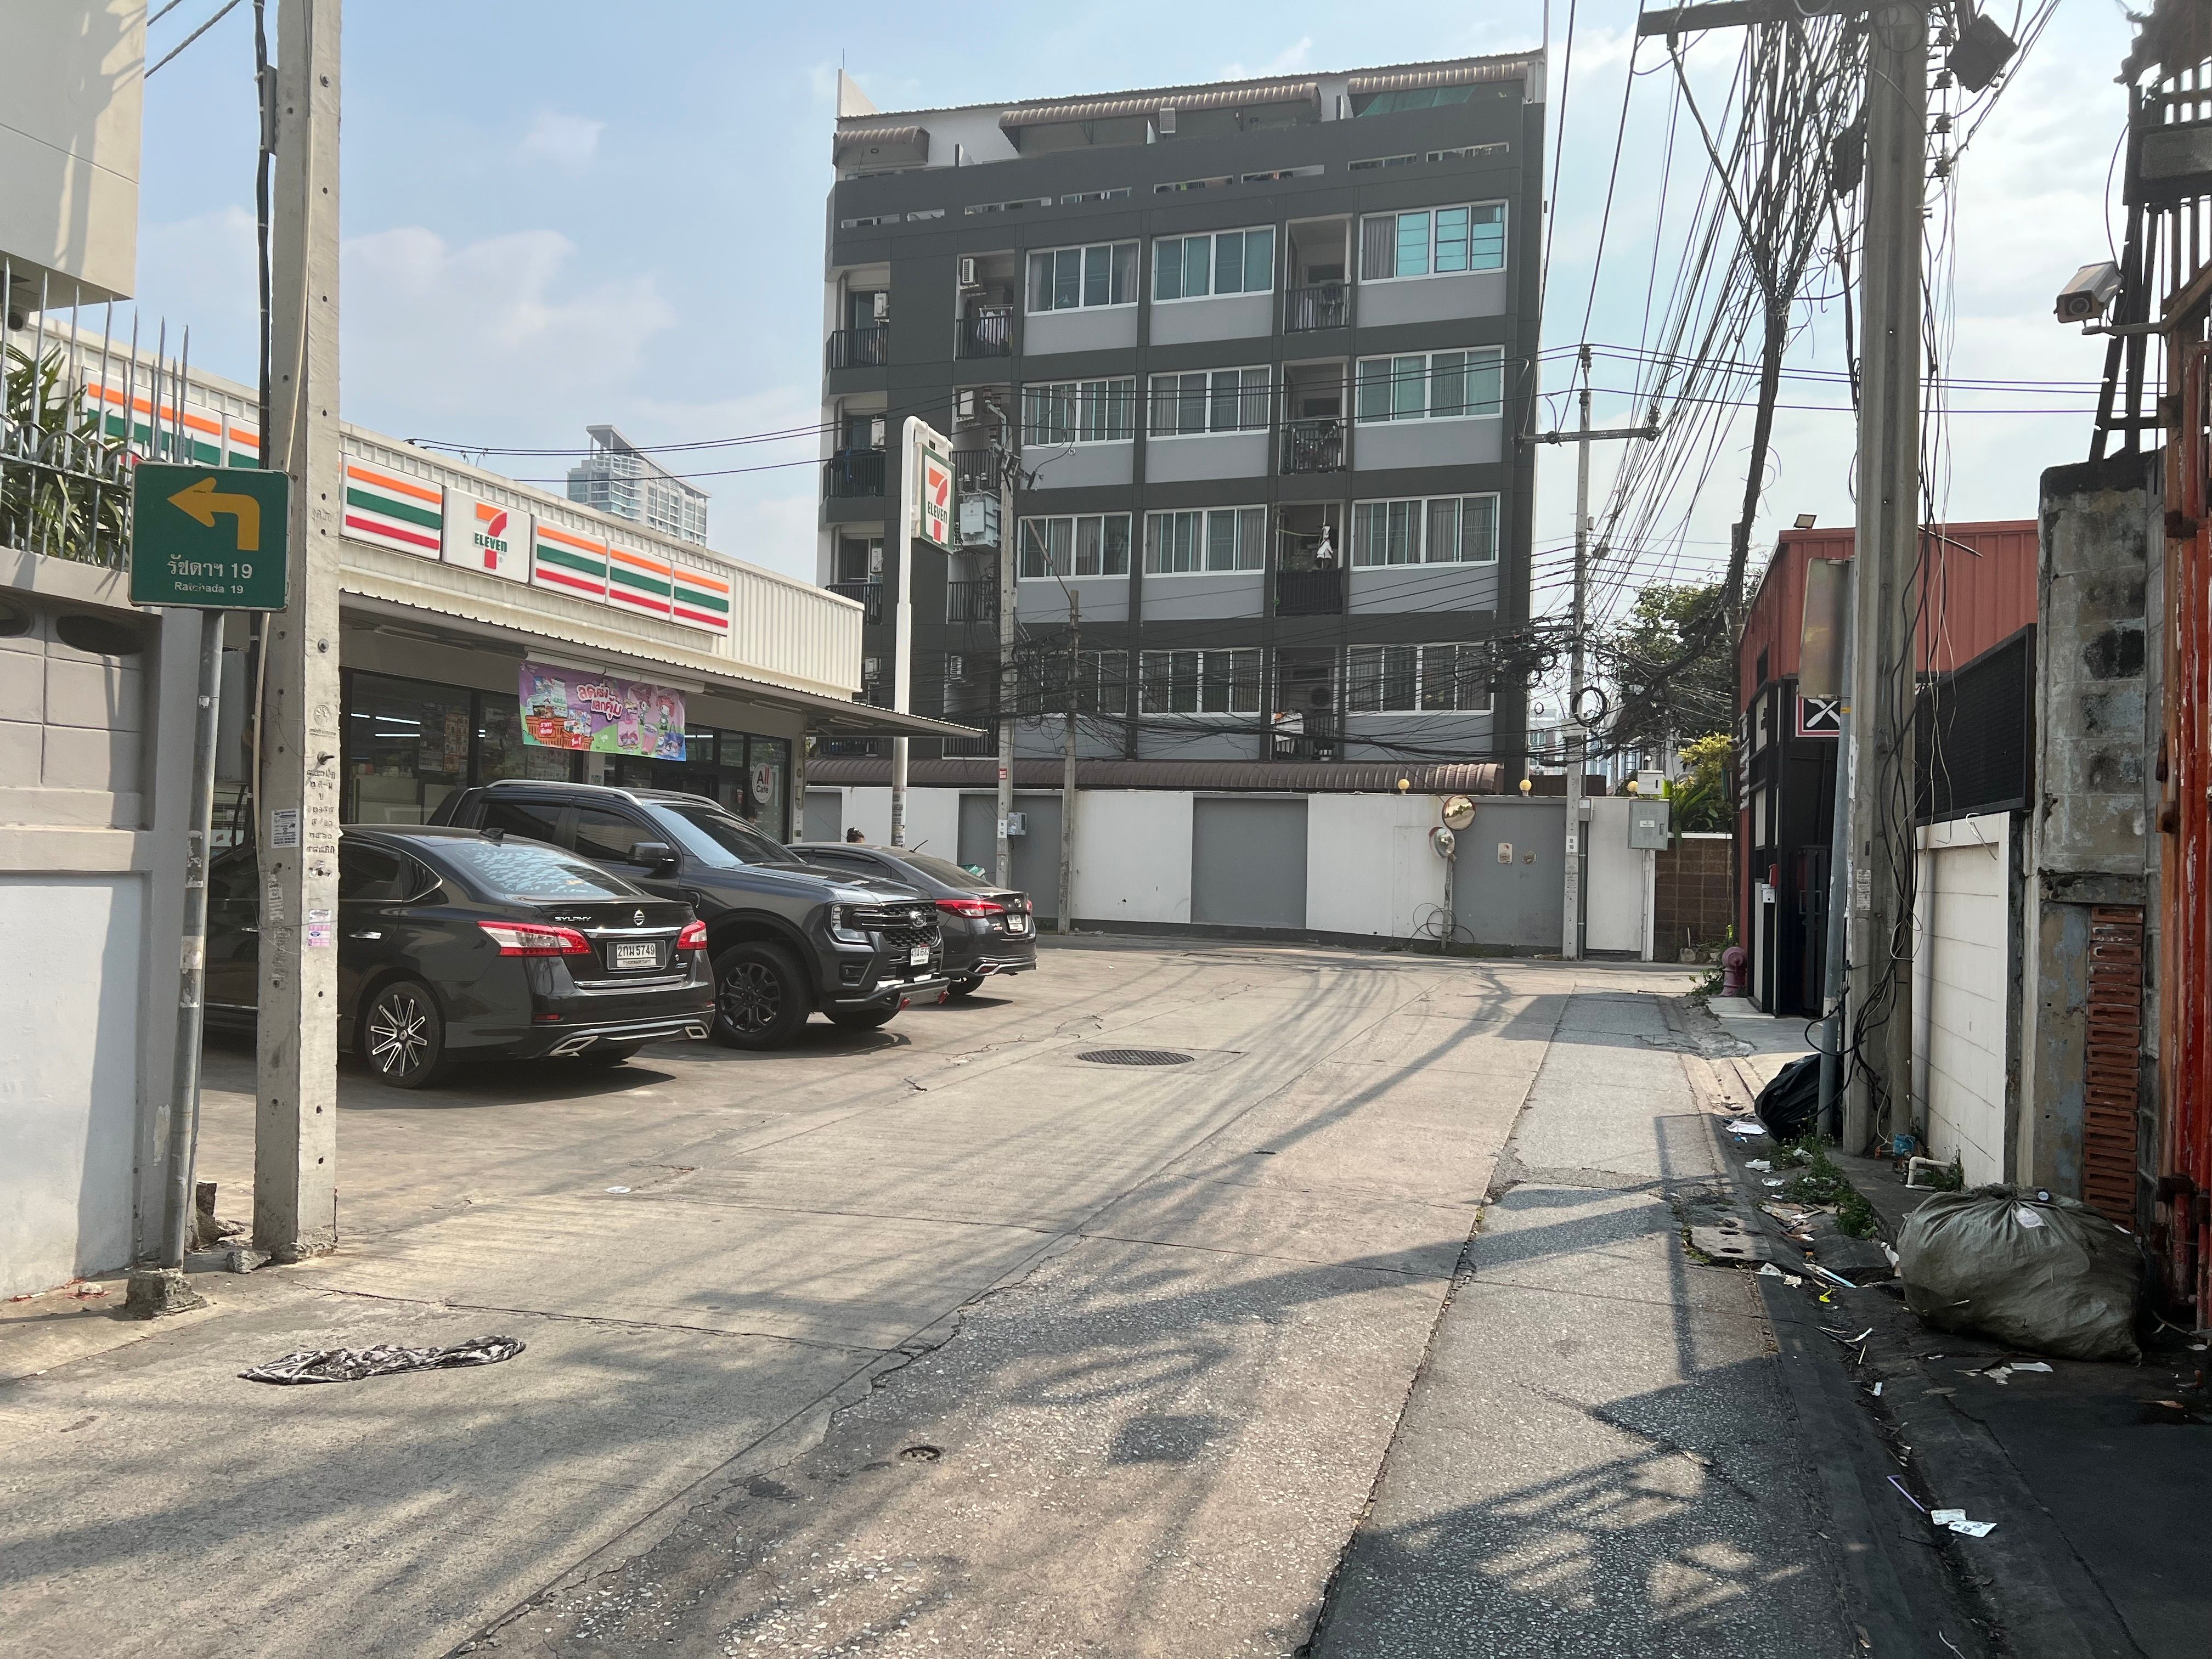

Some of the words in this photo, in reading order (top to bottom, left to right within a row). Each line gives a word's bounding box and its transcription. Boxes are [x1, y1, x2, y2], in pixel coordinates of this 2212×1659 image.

[929, 467, 947, 542] 7
[475, 502, 508, 570] 7
[166, 554, 223, 577] รัชดาฯ
[231, 563, 253, 579] 19
[230, 585, 244, 594] 19
[592, 697, 622, 719] แลกคุ้ม
[636, 944, 655, 956] 5749
